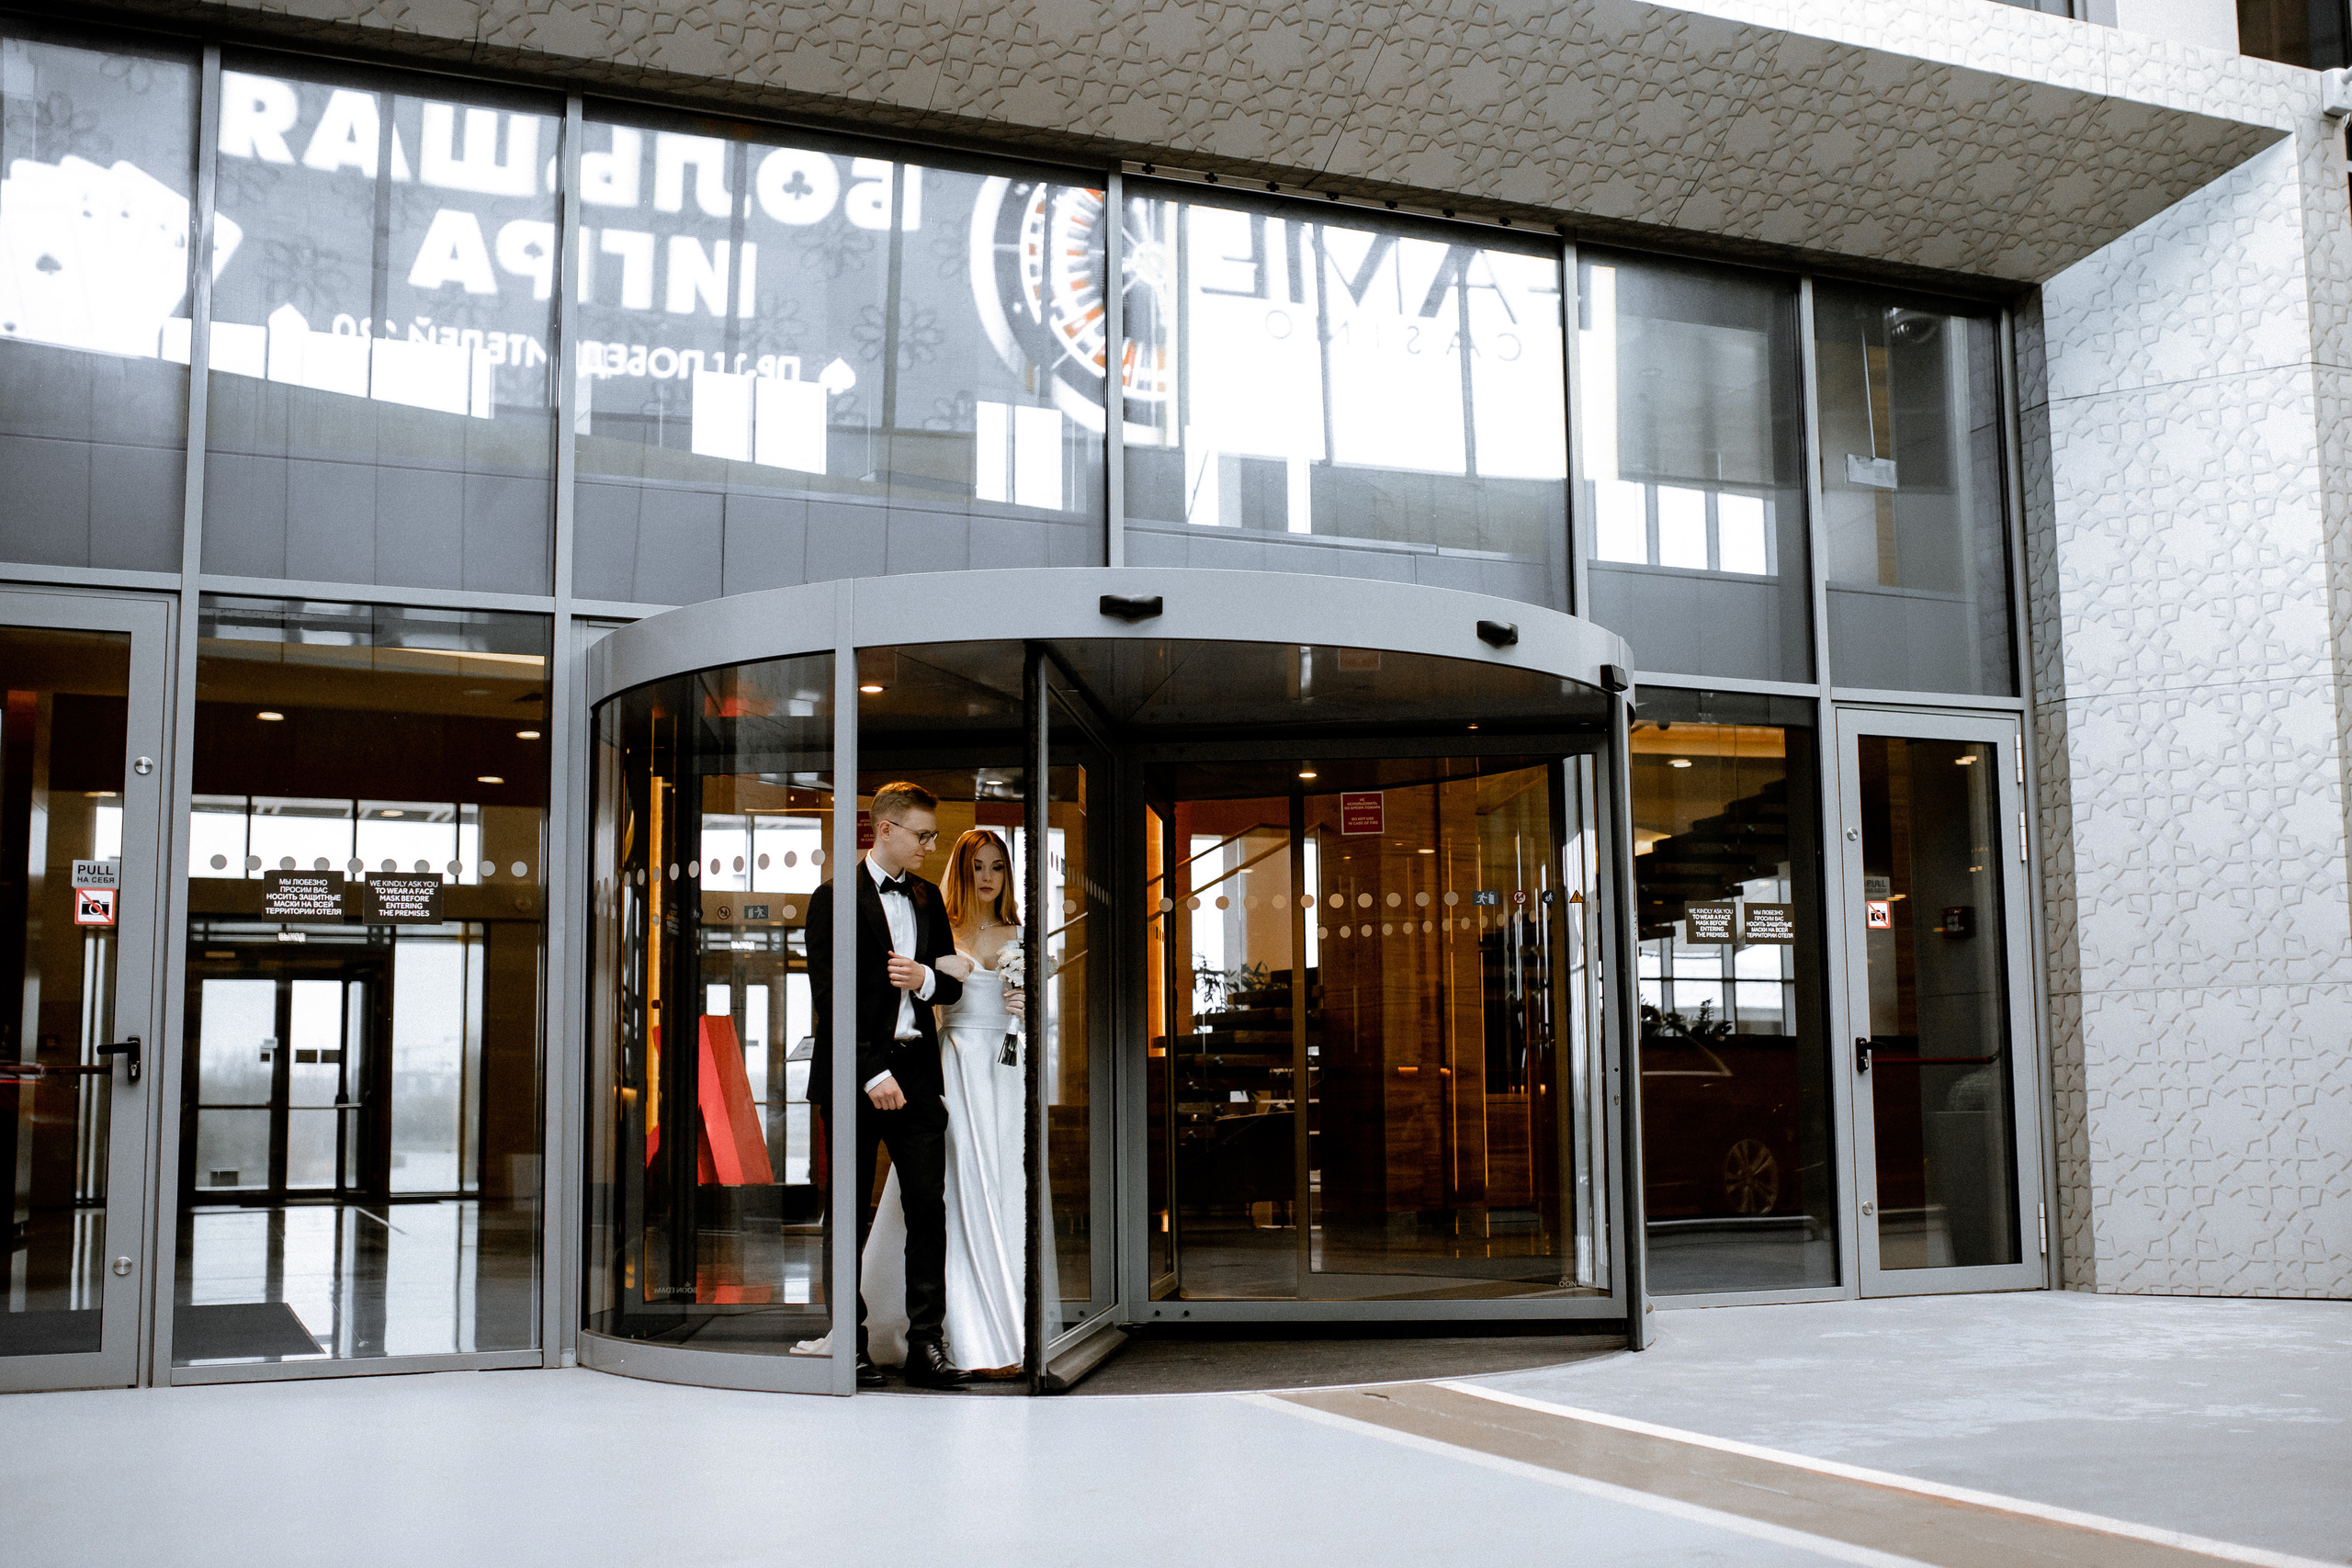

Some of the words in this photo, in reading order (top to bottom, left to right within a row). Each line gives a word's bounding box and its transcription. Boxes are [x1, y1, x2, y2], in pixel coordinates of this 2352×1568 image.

[77, 864, 114, 875] PULL
[292, 878, 328, 886] ЛЮБЕЗНО
[1866, 879, 1886, 887] PULL
[279, 886, 311, 894] ПРОСИМ
[312, 900, 334, 908] ВСЕЙ
[265, 907, 315, 915] ТЕРРИТОРИИ
[316, 908, 342, 916] ОТЕЛЯ
